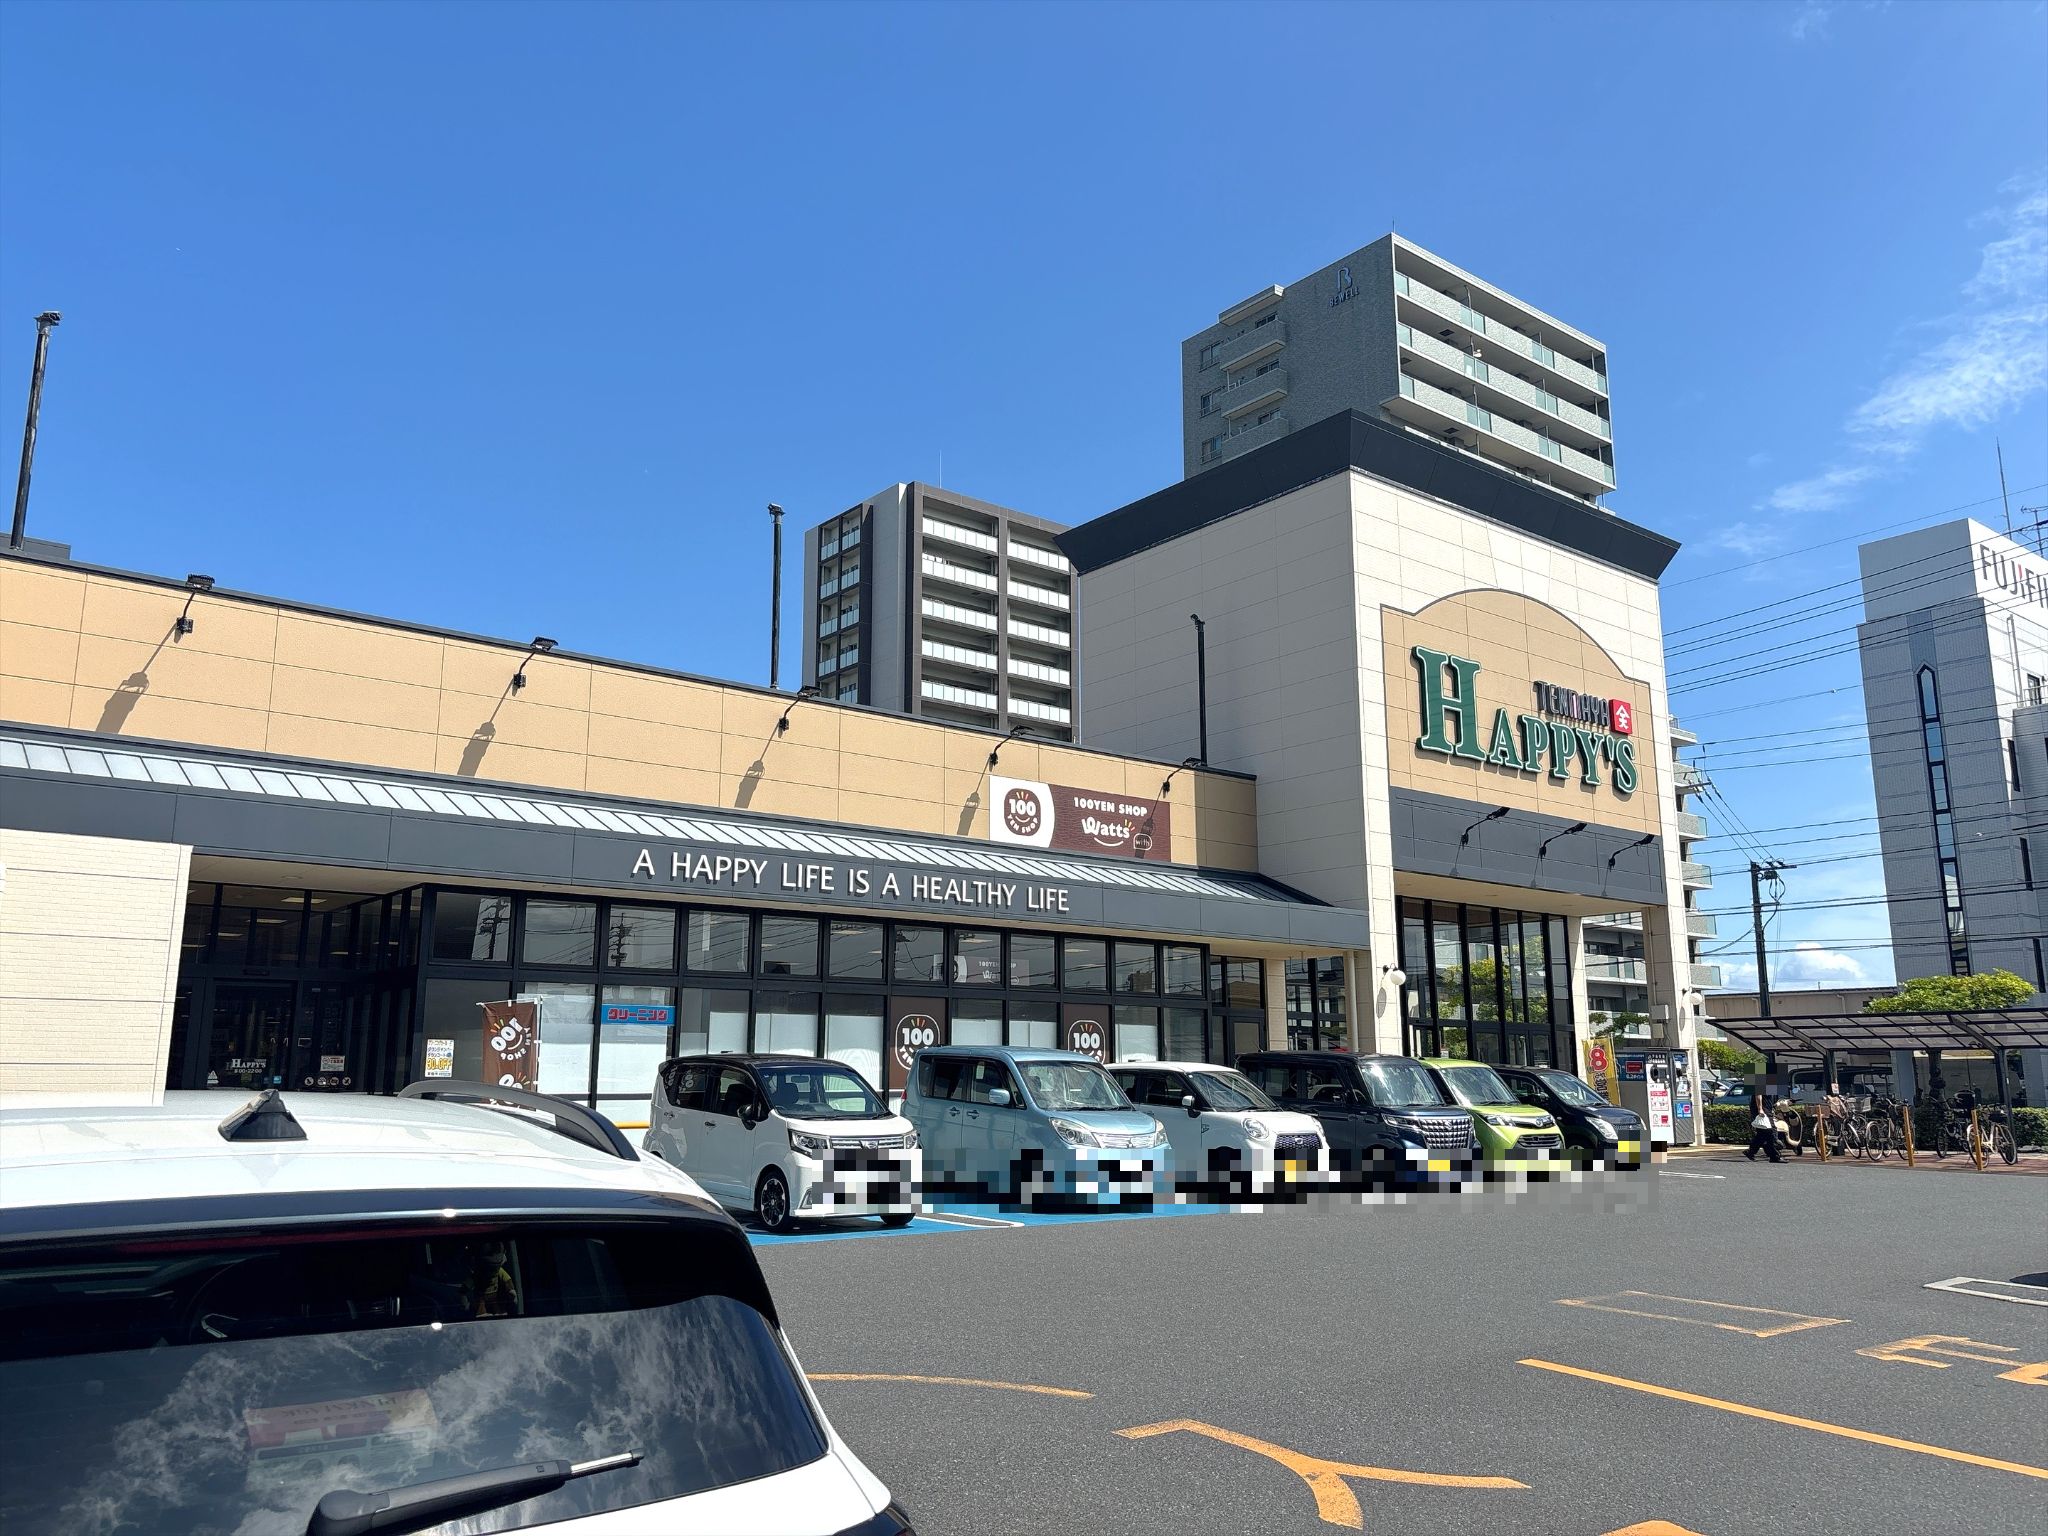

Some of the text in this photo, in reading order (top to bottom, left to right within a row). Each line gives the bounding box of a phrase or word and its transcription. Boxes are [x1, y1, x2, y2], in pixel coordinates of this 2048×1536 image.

[1411, 645, 1638, 794] HAPPY'S
[1009, 799, 1036, 816] 100
[1073, 797, 1148, 817] 100YEN SHOP
[1007, 814, 1038, 834] YEN SHOP
[1081, 816, 1130, 839] Watts
[632, 848, 1069, 911] A HAPPY LIFE IS A HEALTHY LIFE
[607, 1007, 669, 1021] クリーニング
[902, 1028, 934, 1046] 100
[1073, 1032, 1100, 1049] 100
